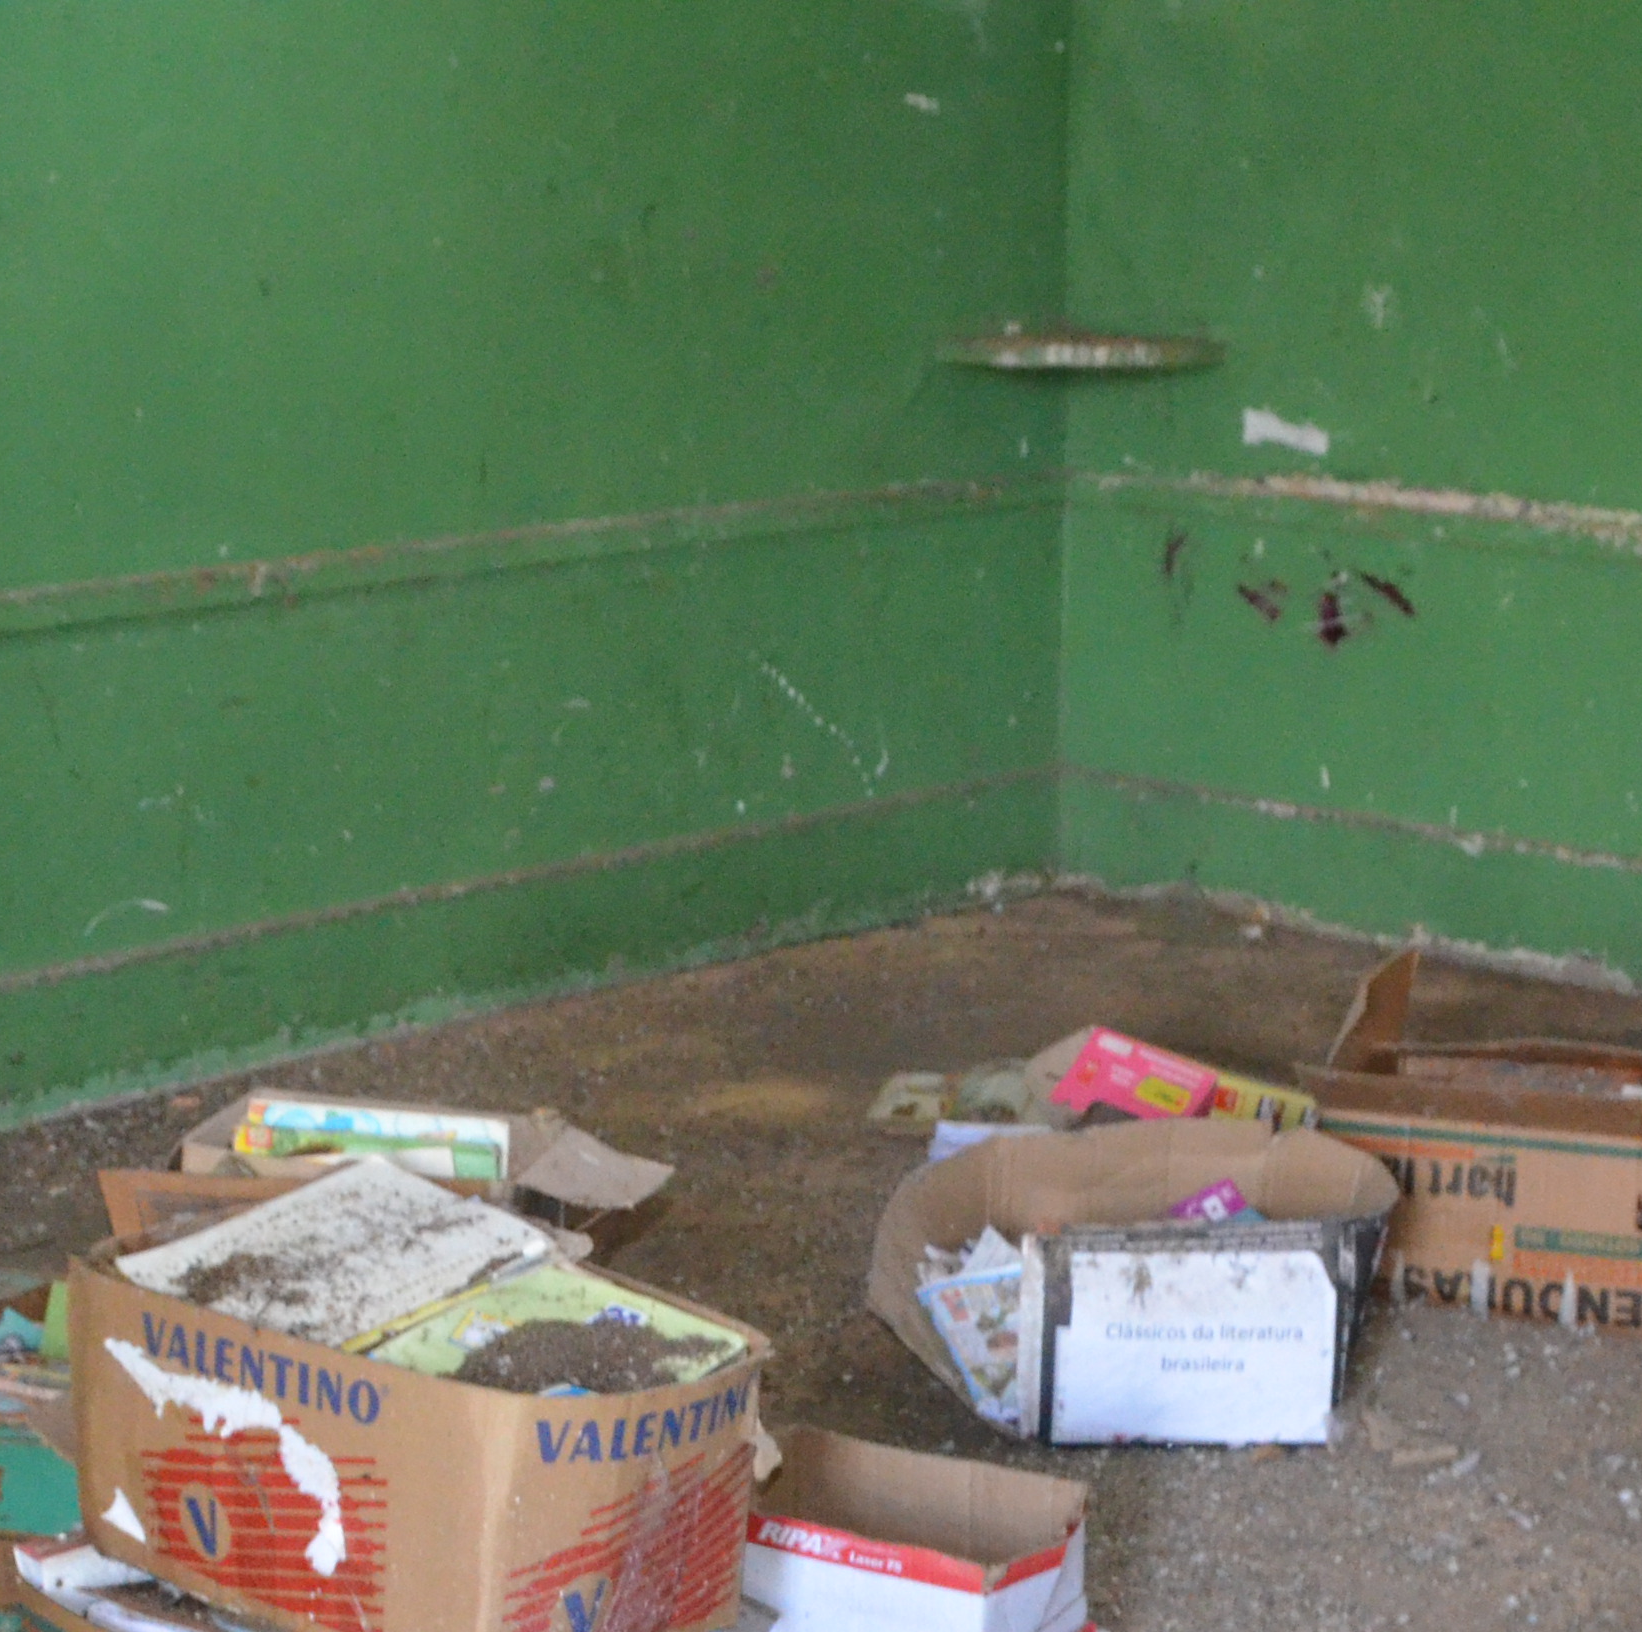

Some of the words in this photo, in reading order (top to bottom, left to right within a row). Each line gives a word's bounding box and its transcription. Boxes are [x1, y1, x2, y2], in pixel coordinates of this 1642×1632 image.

[1106, 1321, 1187, 1340] Clássicos
[1192, 1321, 1214, 1340] da
[1219, 1321, 1303, 1341] literatura
[142, 1312, 380, 1426] VALENTINO
[1160, 1355, 1245, 1373] brasileira
[185, 1496, 219, 1558] V
